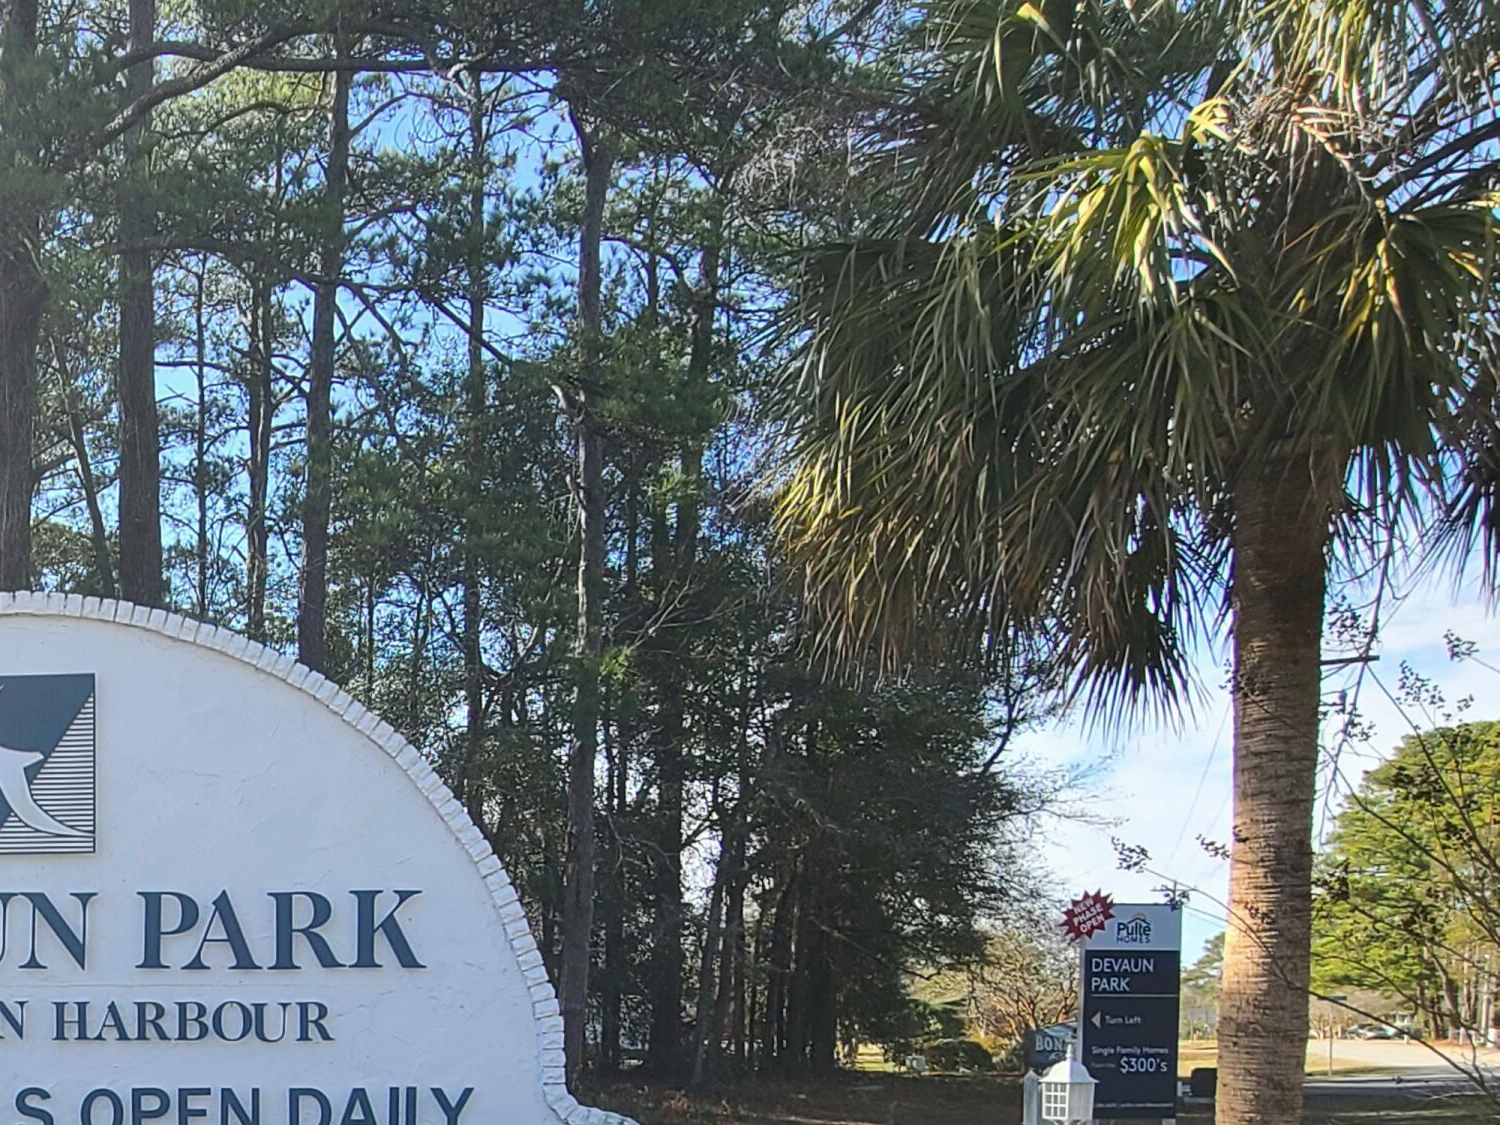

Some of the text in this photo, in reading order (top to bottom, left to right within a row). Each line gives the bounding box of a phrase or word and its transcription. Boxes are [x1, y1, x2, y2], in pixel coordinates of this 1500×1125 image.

[1073, 898, 1094, 914] NEW
[1073, 903, 1104, 927] PHASE
[1080, 914, 1105, 933] OPEN
[136, 889, 427, 970] PARK
[1116, 919, 1152, 937] Pulte
[1116, 935, 1151, 944] HOMES
[1091, 957, 1155, 973] DEVAUN
[1091, 977, 1131, 992] PARK
[51, 1001, 335, 1043] HARBOUR
[1105, 1015, 1142, 1025] Turn Left
[1091, 1046, 1169, 1056] Single Family Homes
[1120, 1056, 1168, 1074] $300's
